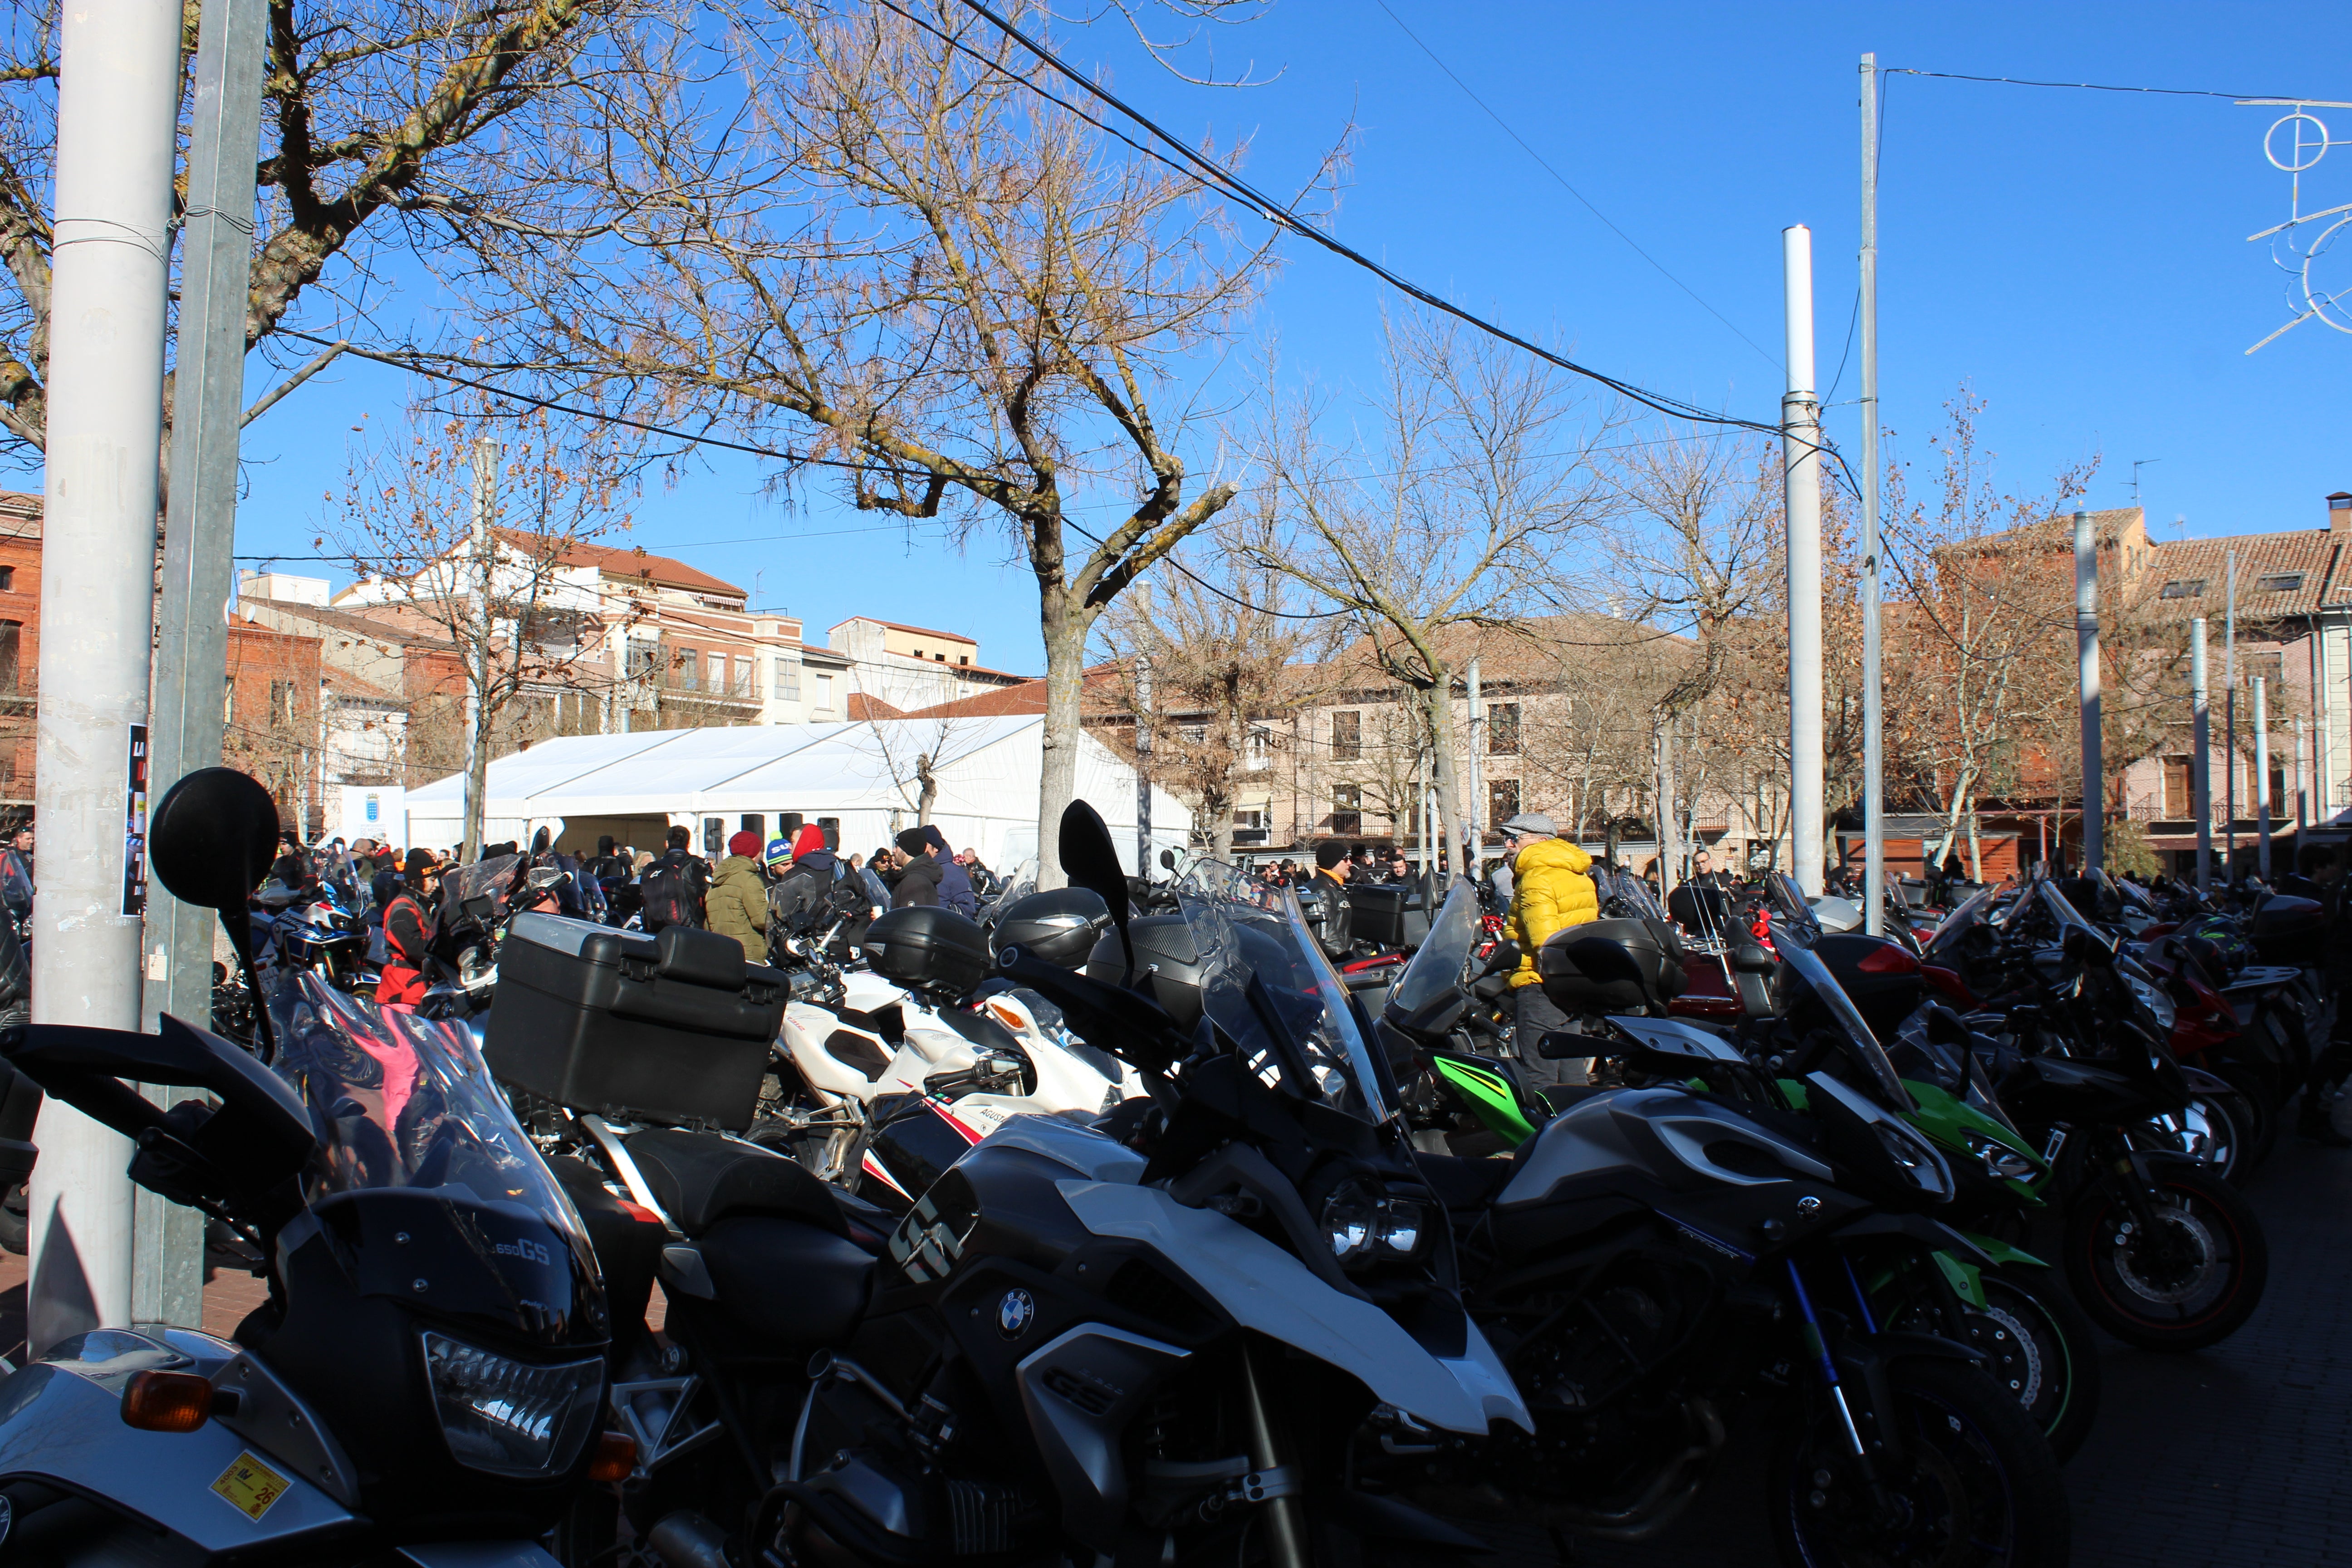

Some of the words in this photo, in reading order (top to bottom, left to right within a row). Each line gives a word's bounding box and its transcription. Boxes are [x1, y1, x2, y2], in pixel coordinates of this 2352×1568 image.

[1091, 913, 1108, 925] SHAD
[1007, 1291, 1032, 1315] BMW
[220, 1465, 239, 1485] 4003
[254, 1487, 275, 1505] 26
